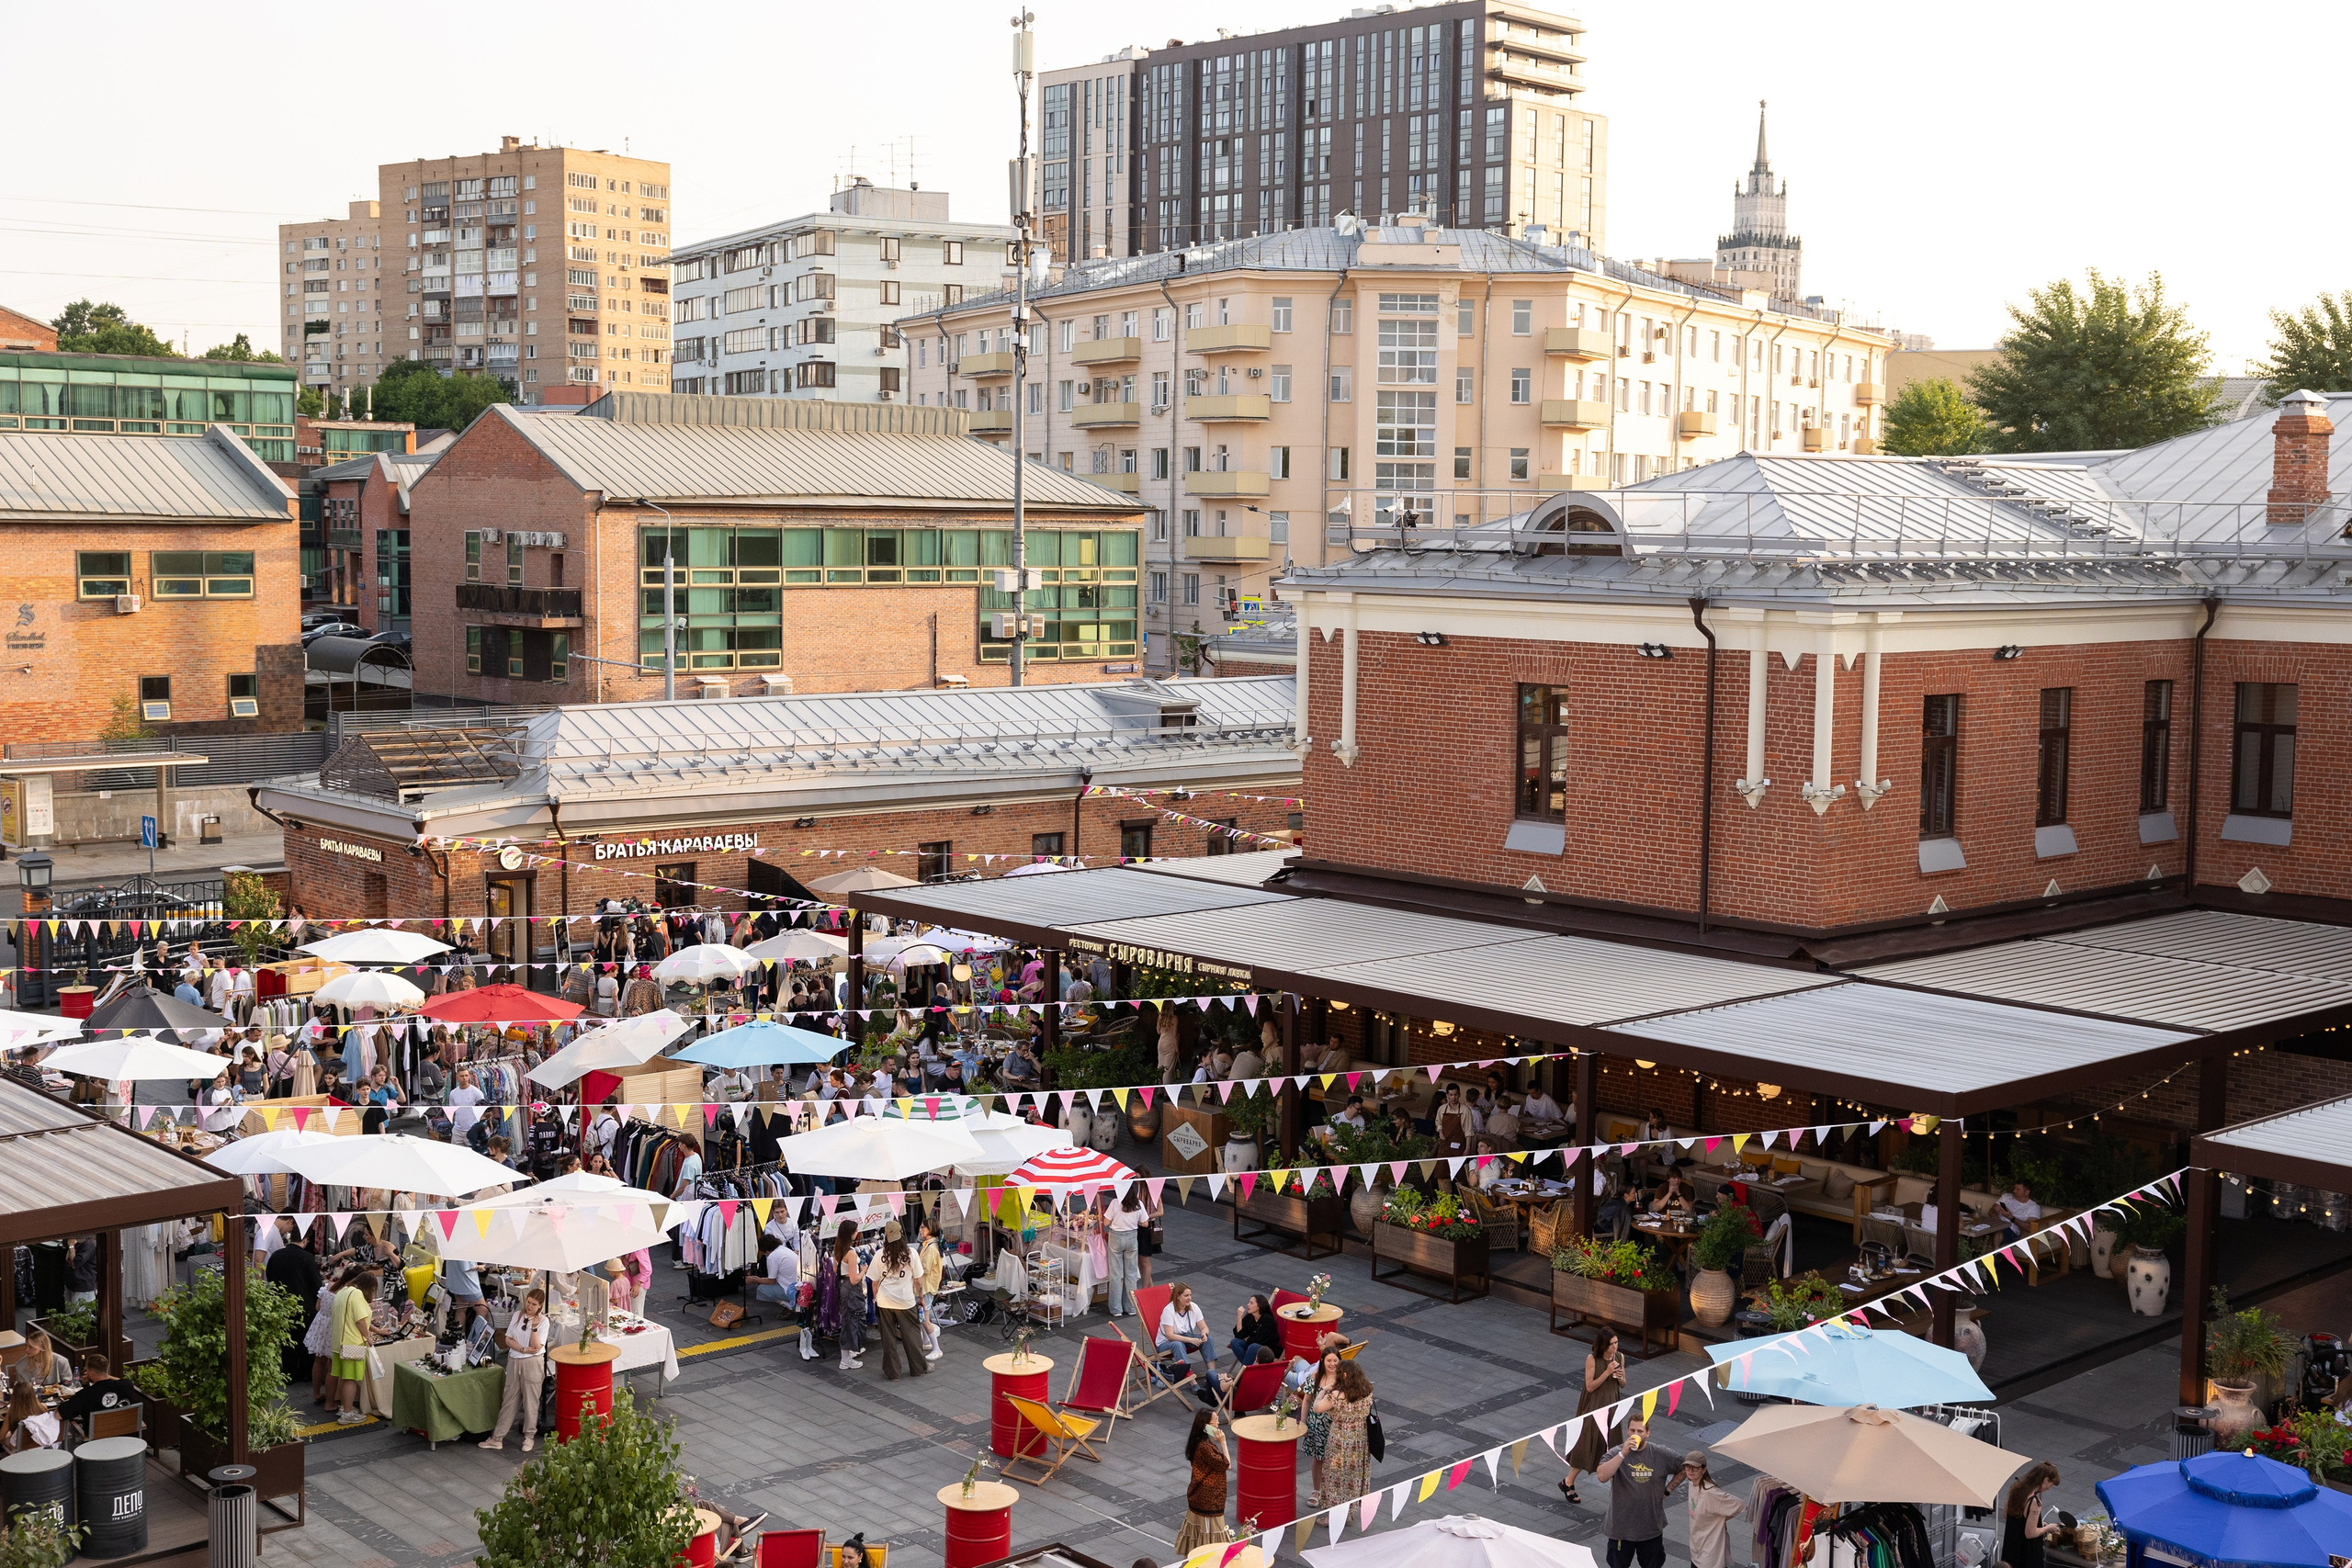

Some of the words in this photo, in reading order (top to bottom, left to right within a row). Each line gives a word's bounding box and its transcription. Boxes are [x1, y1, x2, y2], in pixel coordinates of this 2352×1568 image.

[320, 838, 343, 854] БРАТЬЯ
[344, 843, 382, 863] КАРАВАЕВЫ
[595, 840, 656, 860] БРАТЬЯ
[661, 832, 758, 854] КАРАВАЕВЫ
[1069, 939, 1104, 953] РЕСТОРАН
[1198, 962, 1227, 976] СЫРНАЯ
[1227, 968, 1252, 980] ЛАВКА
[112, 1490, 143, 1517] ДЕПО
